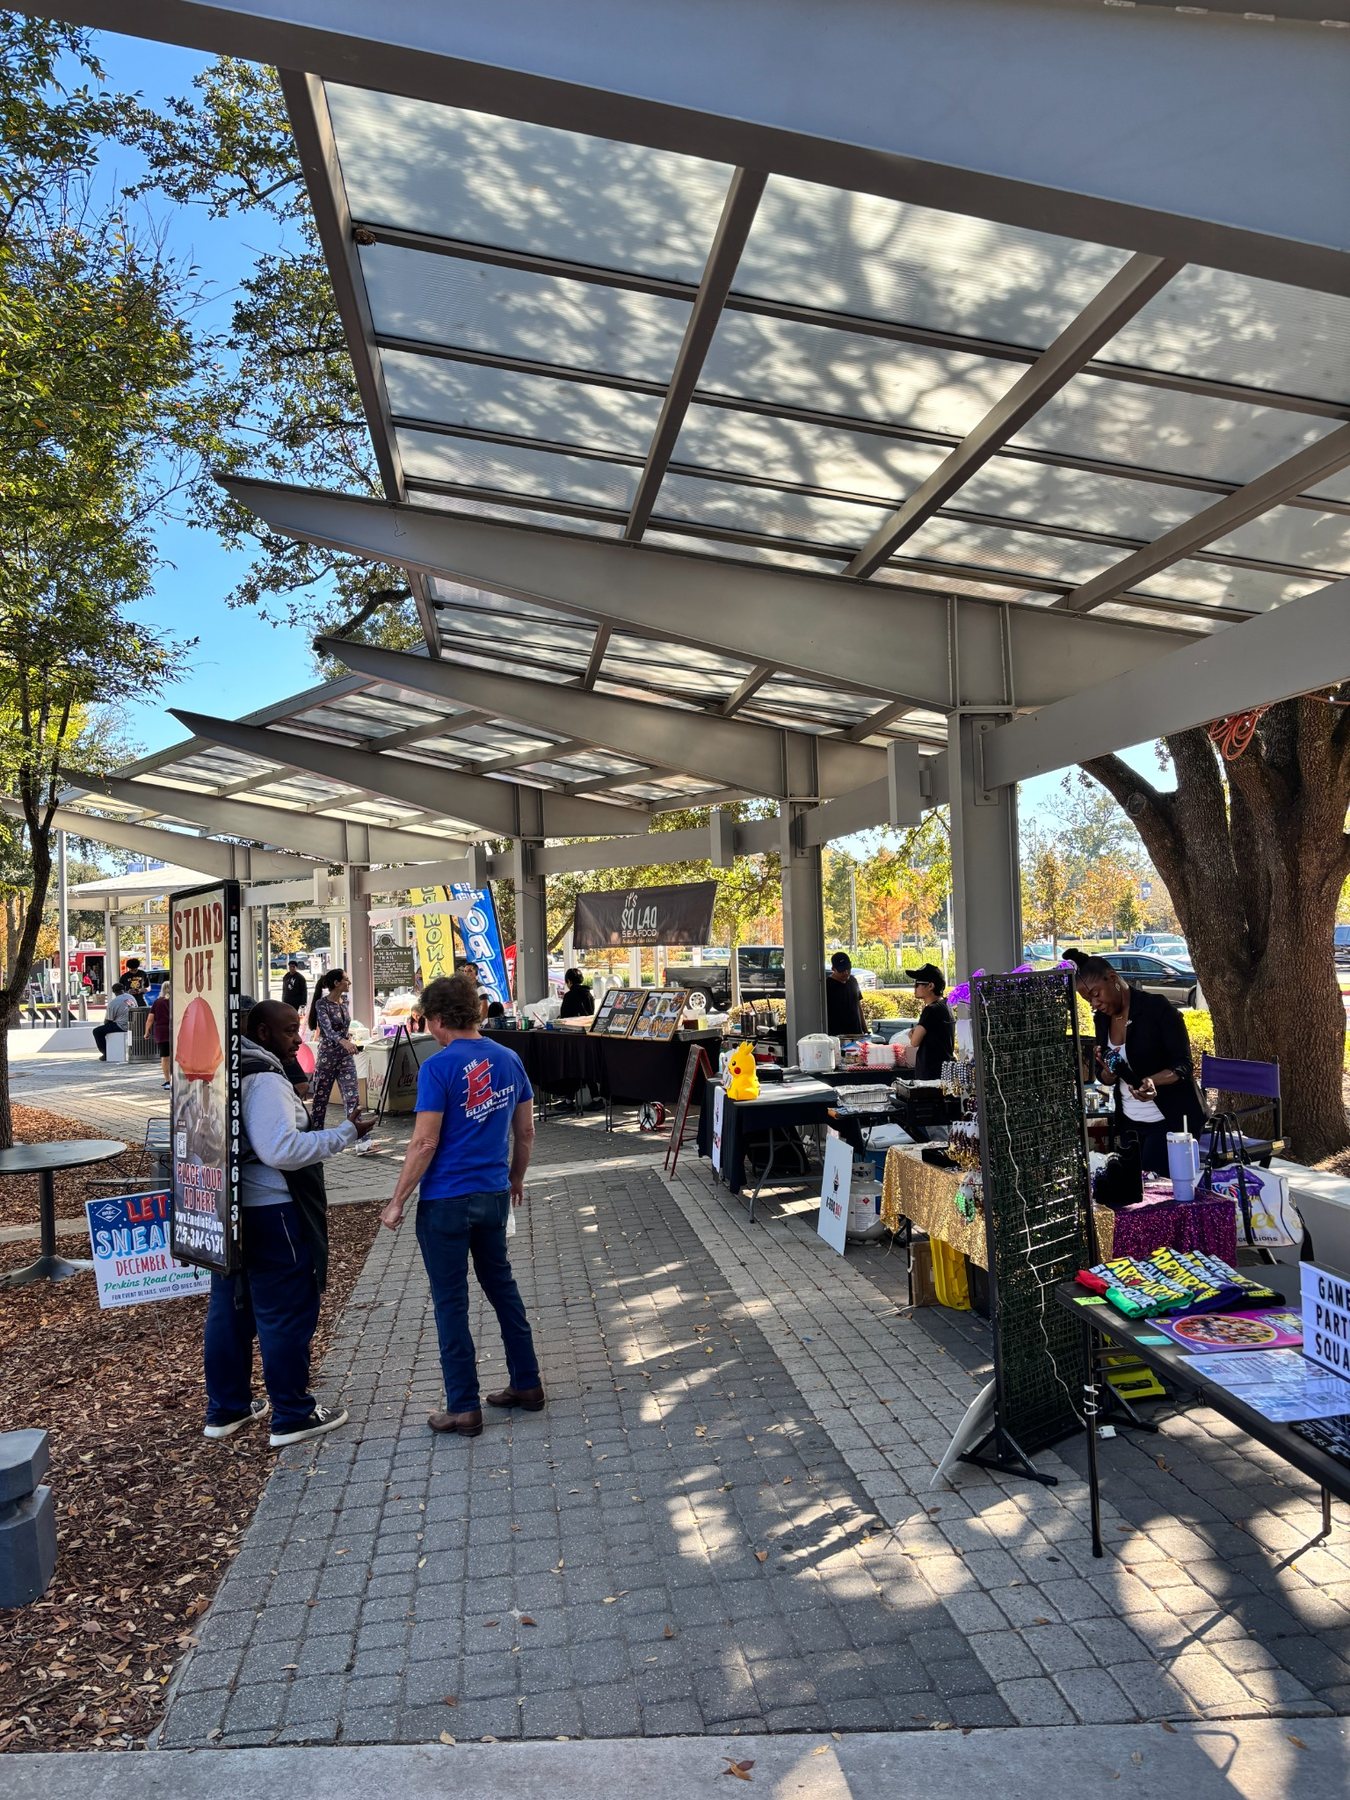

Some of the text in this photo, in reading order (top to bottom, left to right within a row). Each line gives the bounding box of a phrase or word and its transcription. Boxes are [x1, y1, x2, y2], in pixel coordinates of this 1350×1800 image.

[174, 902, 223, 951] STAND
[621, 906, 657, 930] SO LAO
[230, 915, 239, 988] RENT
[184, 949, 214, 994] OUT
[229, 994, 240, 1029] ME
[463, 1059, 479, 1073] THE
[177, 1162, 223, 1191] PLACE YOUR
[126, 1194, 168, 1222] LET
[183, 1187, 216, 1214] AD HERE
[116, 1254, 168, 1277] DECEMBER
[104, 1281, 140, 1293] Perkins
[143, 1275, 167, 1286] Road
[122, 1291, 137, 1299] EVENT
[1318, 1276, 1350, 1312] GAME
[1315, 1332, 1350, 1371] SQUA
